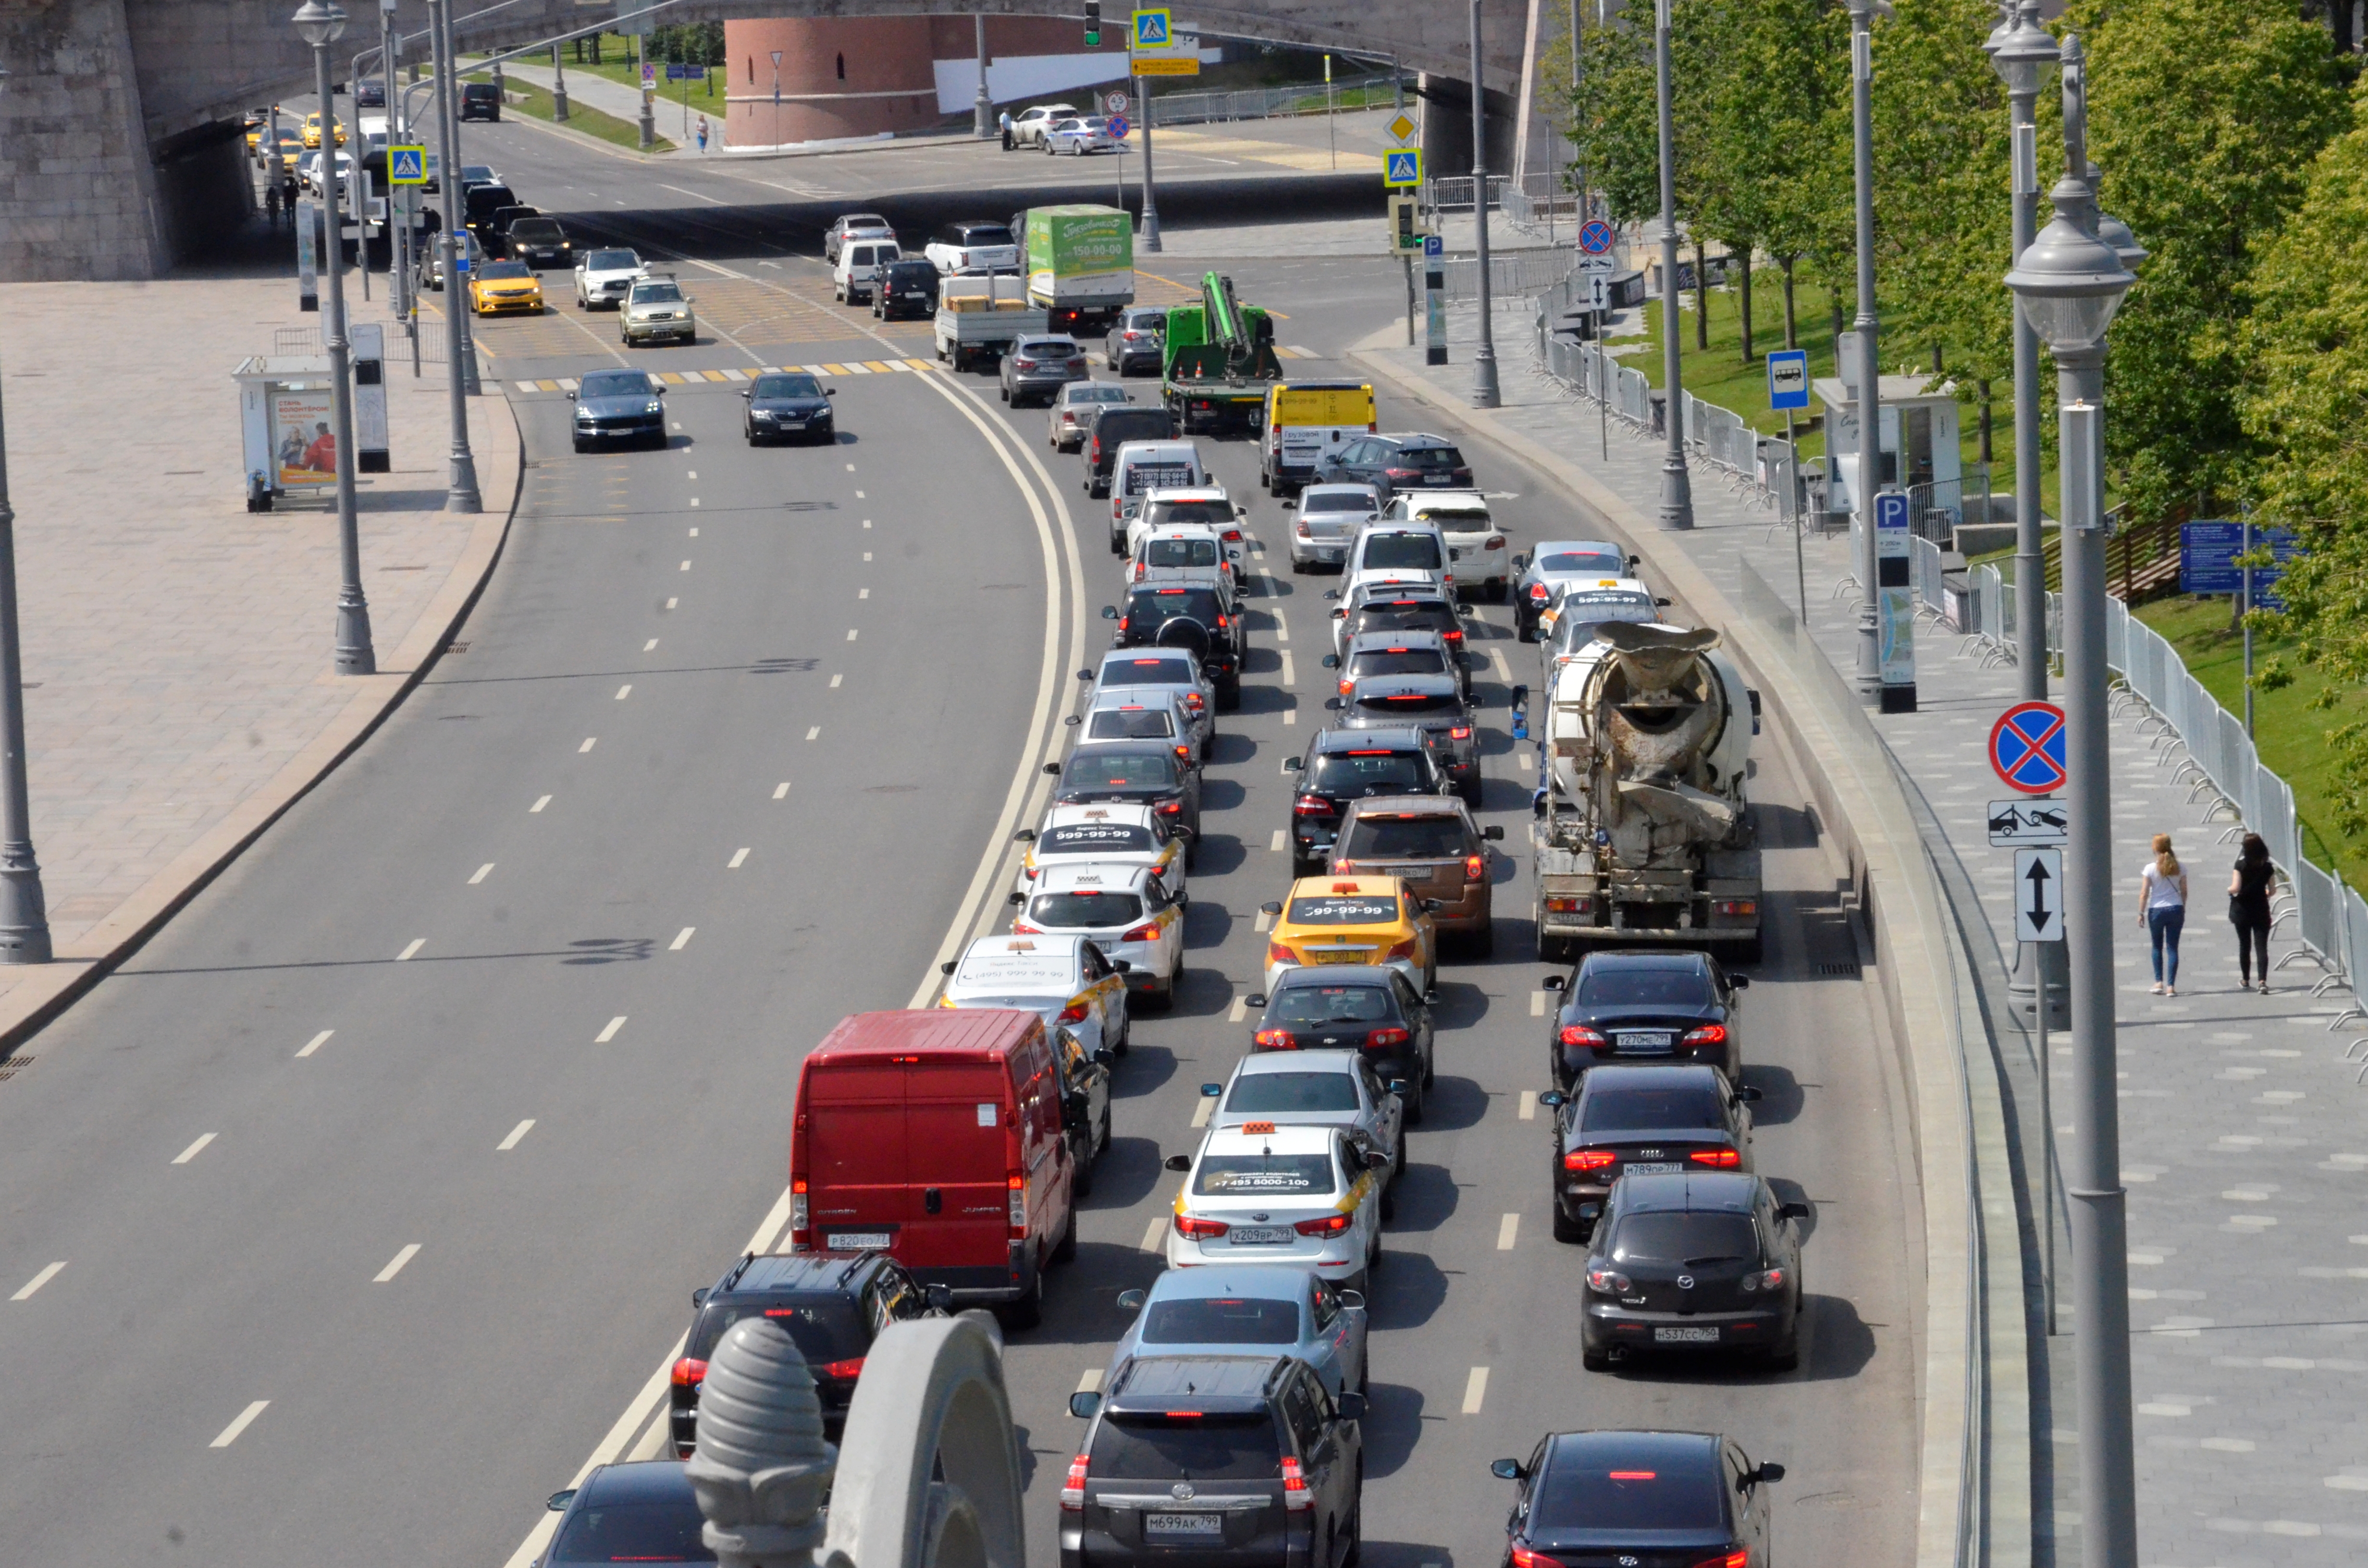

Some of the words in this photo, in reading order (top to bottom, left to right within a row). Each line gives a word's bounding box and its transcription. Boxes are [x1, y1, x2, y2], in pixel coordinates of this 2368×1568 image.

[1073, 244, 1122, 256] 150-00-00
[1429, 239, 1439, 254] P
[1885, 499, 1902, 525] P
[1057, 831, 1131, 840] 999-99-99
[1620, 1035, 1653, 1044] У270МЕ
[832, 1236, 873, 1245] Р820ЕО
[1234, 1230, 1272, 1241] Х209ВР
[1275, 1229, 1290, 1237] 799
[1658, 1329, 1698, 1339] Н537СС
[1701, 1328, 1716, 1336] 750
[1150, 1516, 1197, 1529] М699АК
[1200, 1516, 1218, 1526] 799
